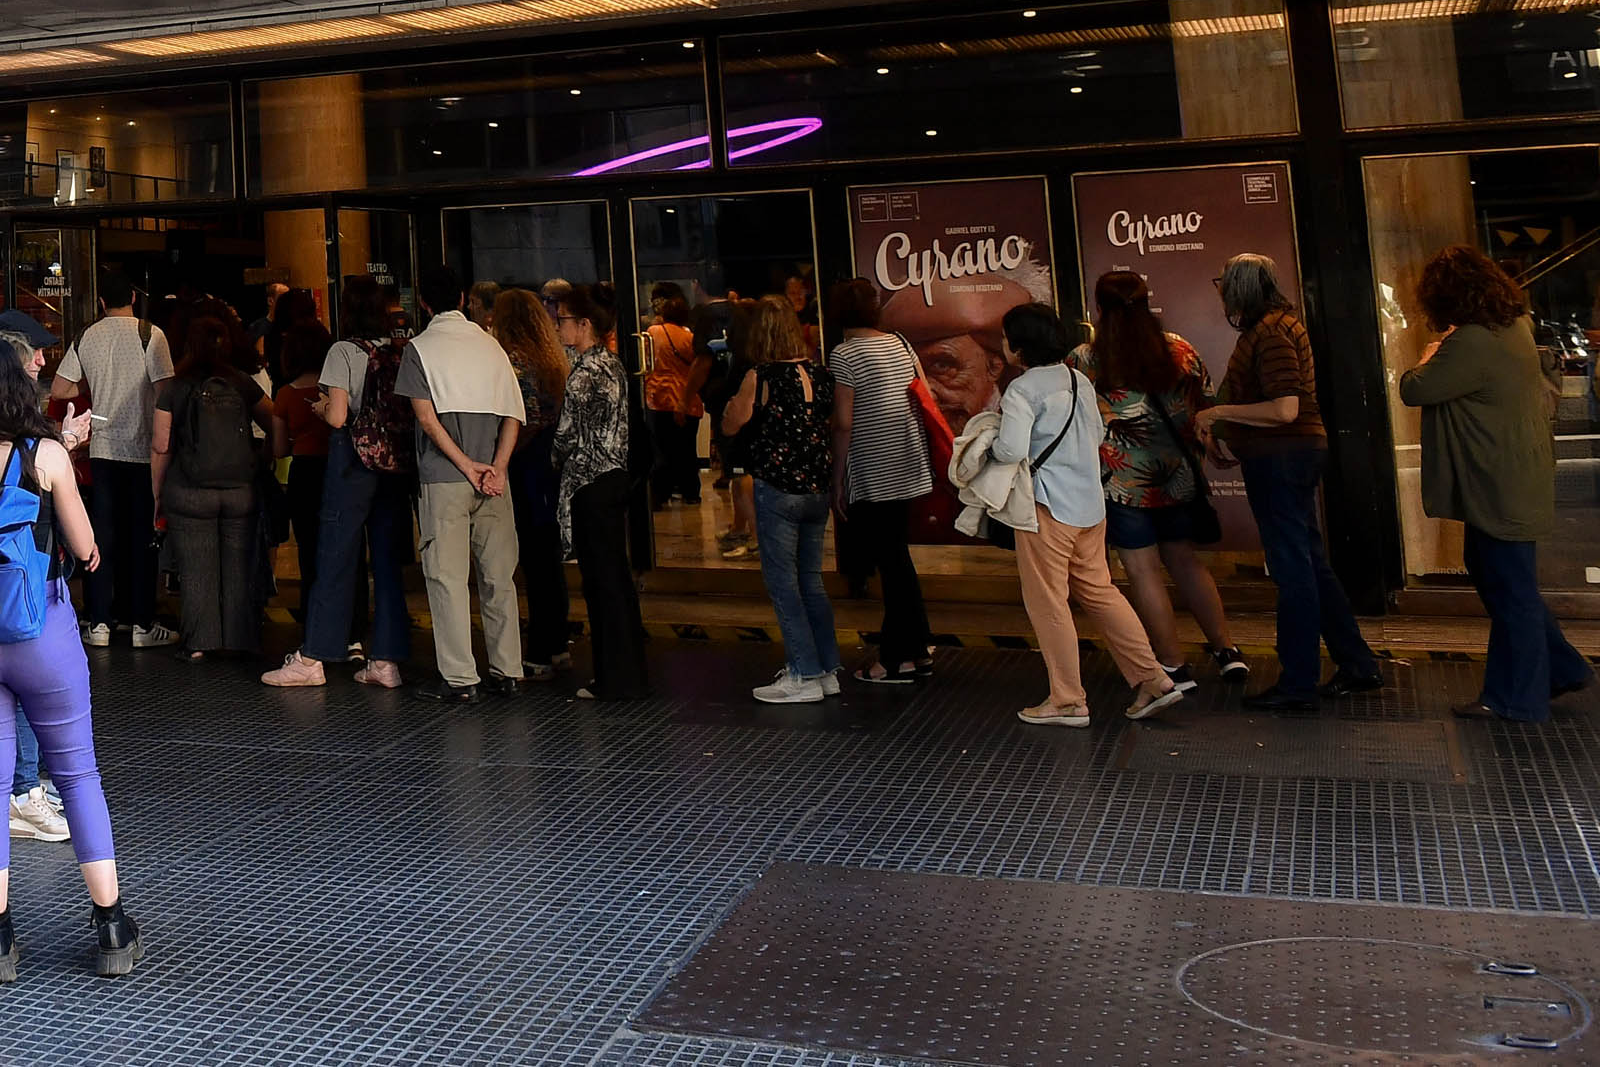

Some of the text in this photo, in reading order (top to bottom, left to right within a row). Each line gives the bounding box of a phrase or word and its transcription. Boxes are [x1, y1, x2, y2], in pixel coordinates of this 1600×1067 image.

[1107, 210, 1203, 255] Cyrano
[366, 262, 388, 273] TEATRO
[875, 232, 1028, 307] Cyrano
